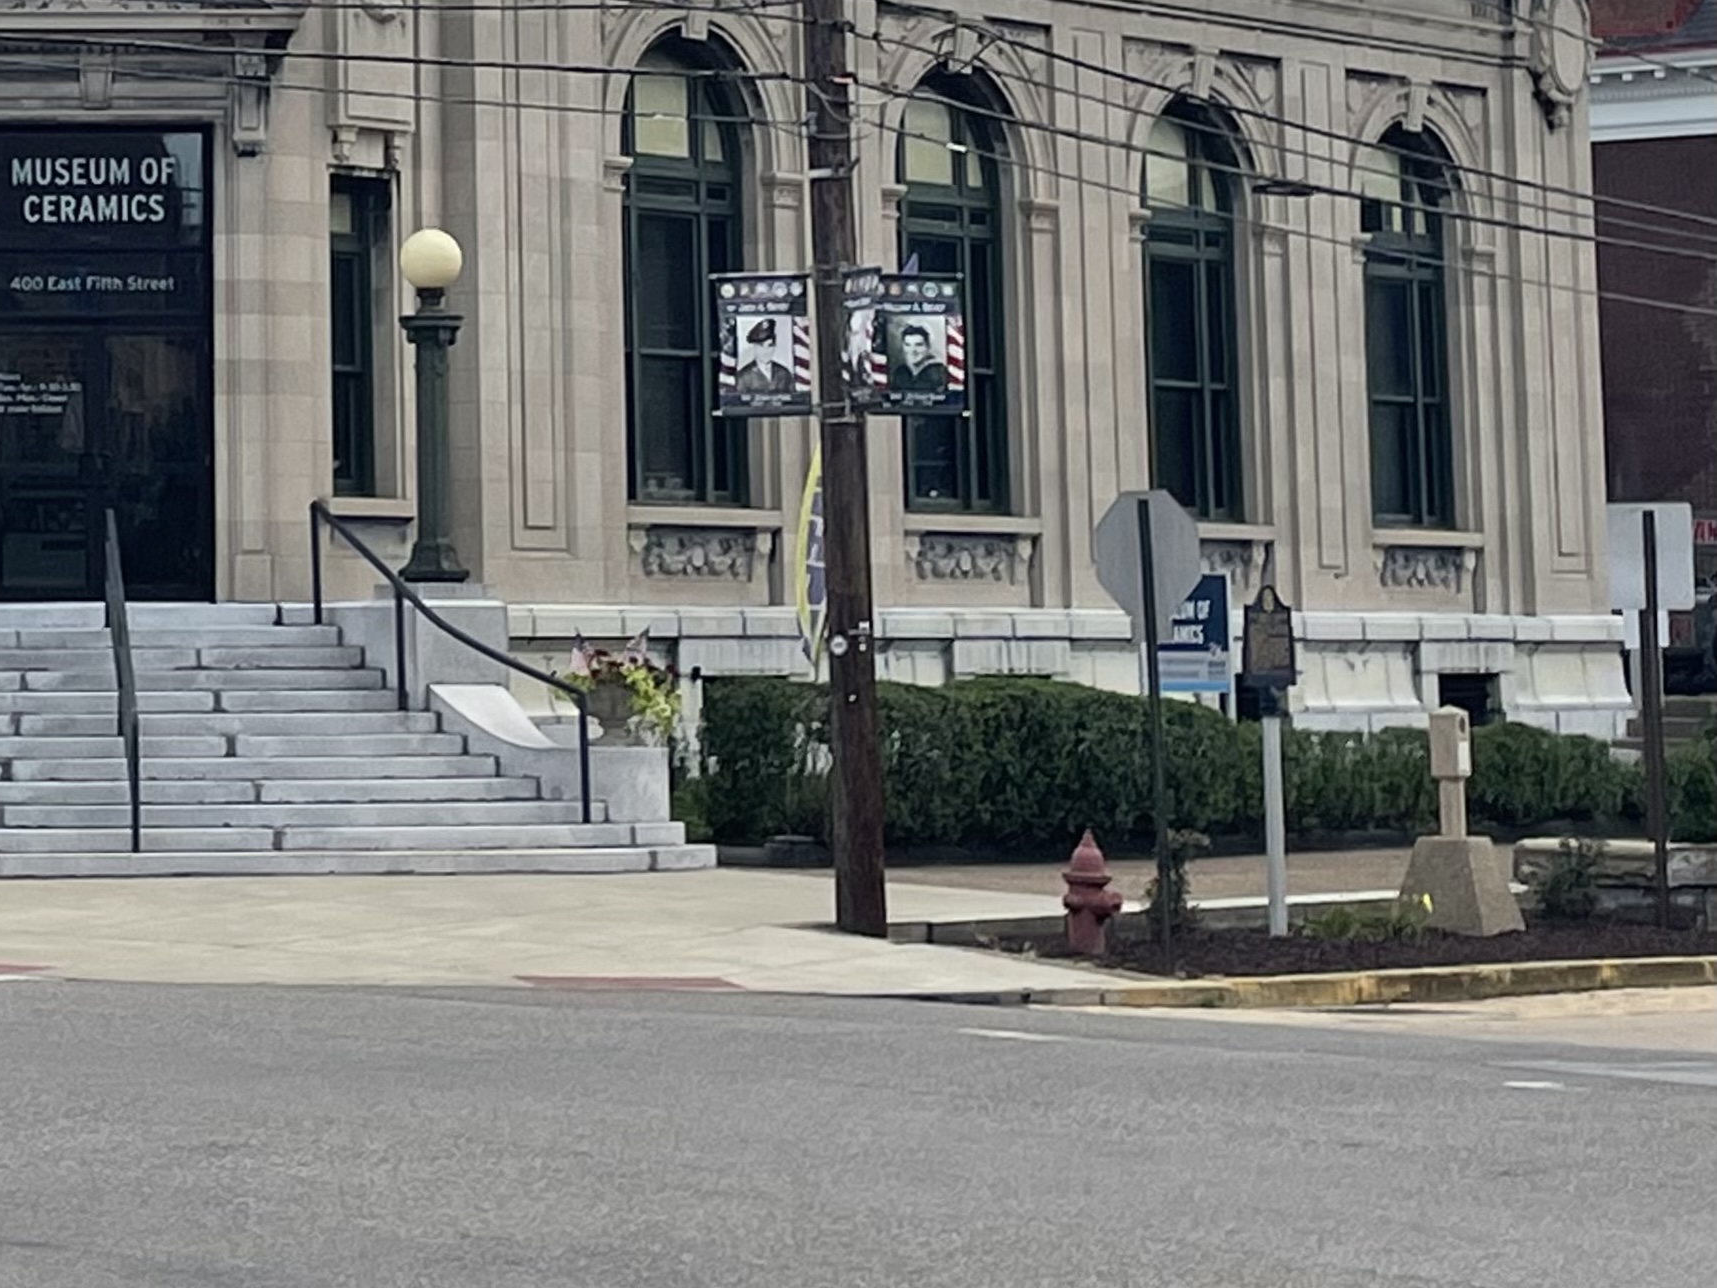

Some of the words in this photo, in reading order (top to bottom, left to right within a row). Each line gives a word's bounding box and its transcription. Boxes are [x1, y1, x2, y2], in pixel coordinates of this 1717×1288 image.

[11, 157, 131, 186] MUSEUM
[140, 156, 176, 185] OF
[23, 194, 165, 223] CERAMICS
[9, 275, 44, 291] 400
[47, 275, 82, 291] East
[85, 275, 123, 291] Fifth
[126, 275, 174, 291] Street
[1196, 599, 1212, 621] OF
